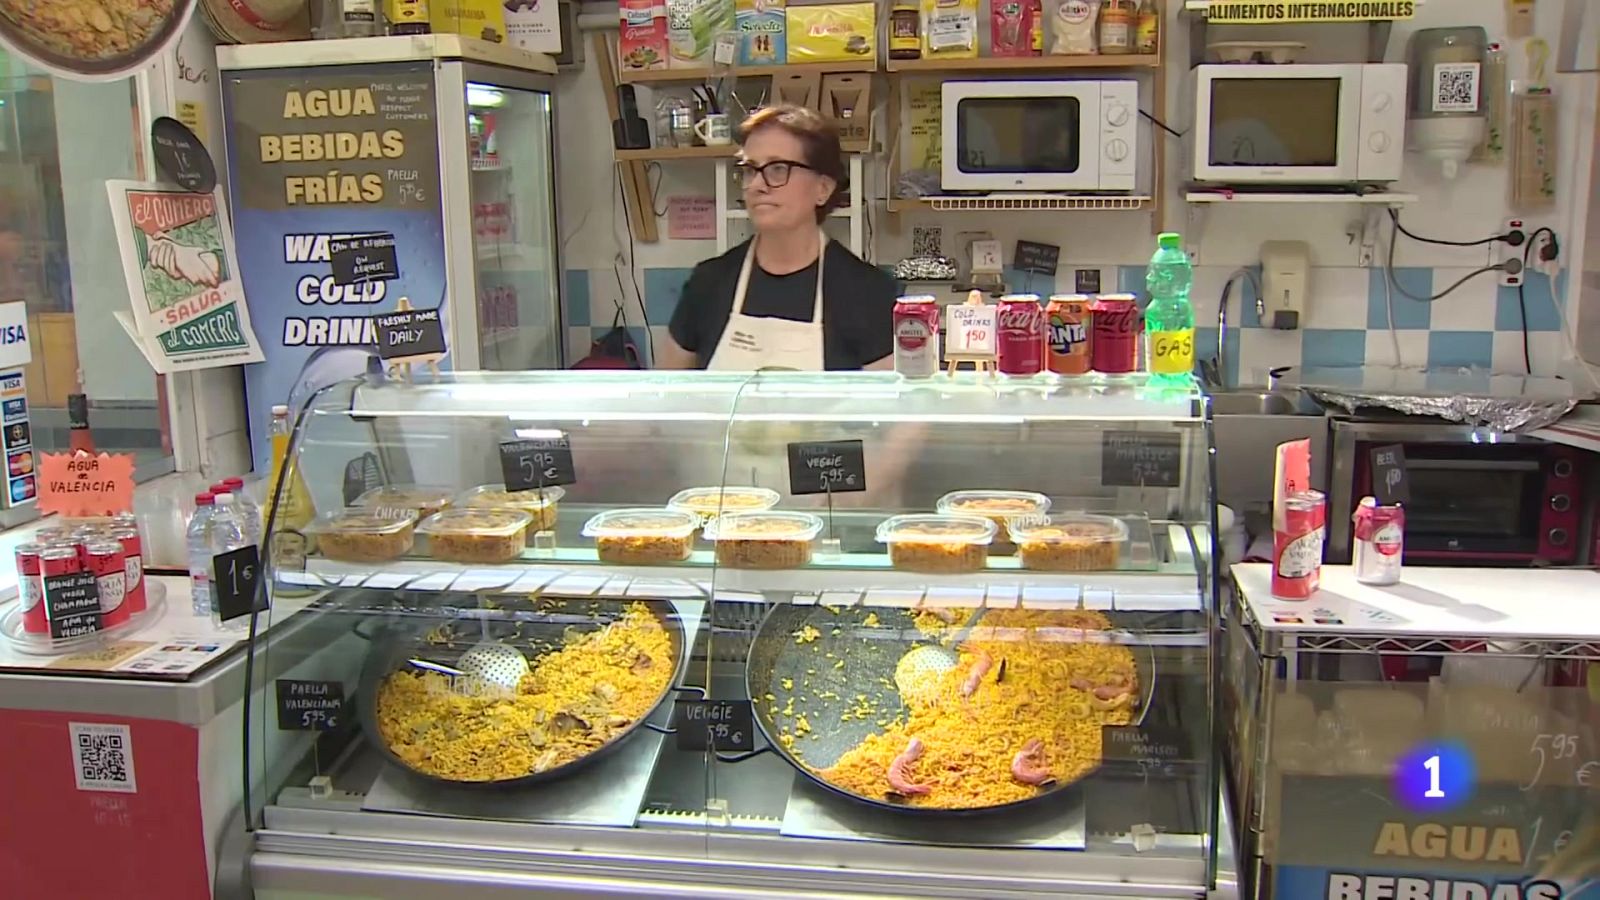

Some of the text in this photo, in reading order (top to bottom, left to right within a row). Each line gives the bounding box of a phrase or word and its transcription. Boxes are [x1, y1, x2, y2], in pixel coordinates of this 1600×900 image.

[1208, 0, 1413, 20] ALIMENTOS INTERNACIONALES
[283, 87, 376, 118] AGUA
[259, 130, 405, 162] BEBIDAS
[387, 169, 419, 181] PAELLA
[285, 171, 384, 205] FRÍAS
[165, 291, 222, 325] SALVA
[953, 309, 974, 319] COLD
[389, 329, 424, 347] DAILY
[1154, 337, 1191, 356] GAS
[4, 380, 20, 389] VISA
[67, 460, 98, 472] AGUA
[519, 453, 558, 482] 595 €
[50, 481, 115, 493] VALENCIA
[820, 469, 844, 490] 595
[228, 559, 253, 596] 1 €
[290, 683, 328, 695] PAELLA
[302, 710, 326, 726] 595
[686, 701, 733, 720] VEGGIE
[706, 724, 743, 744] 595 €
[1520, 734, 1579, 792] 595
[1373, 822, 1523, 864] AGUA
